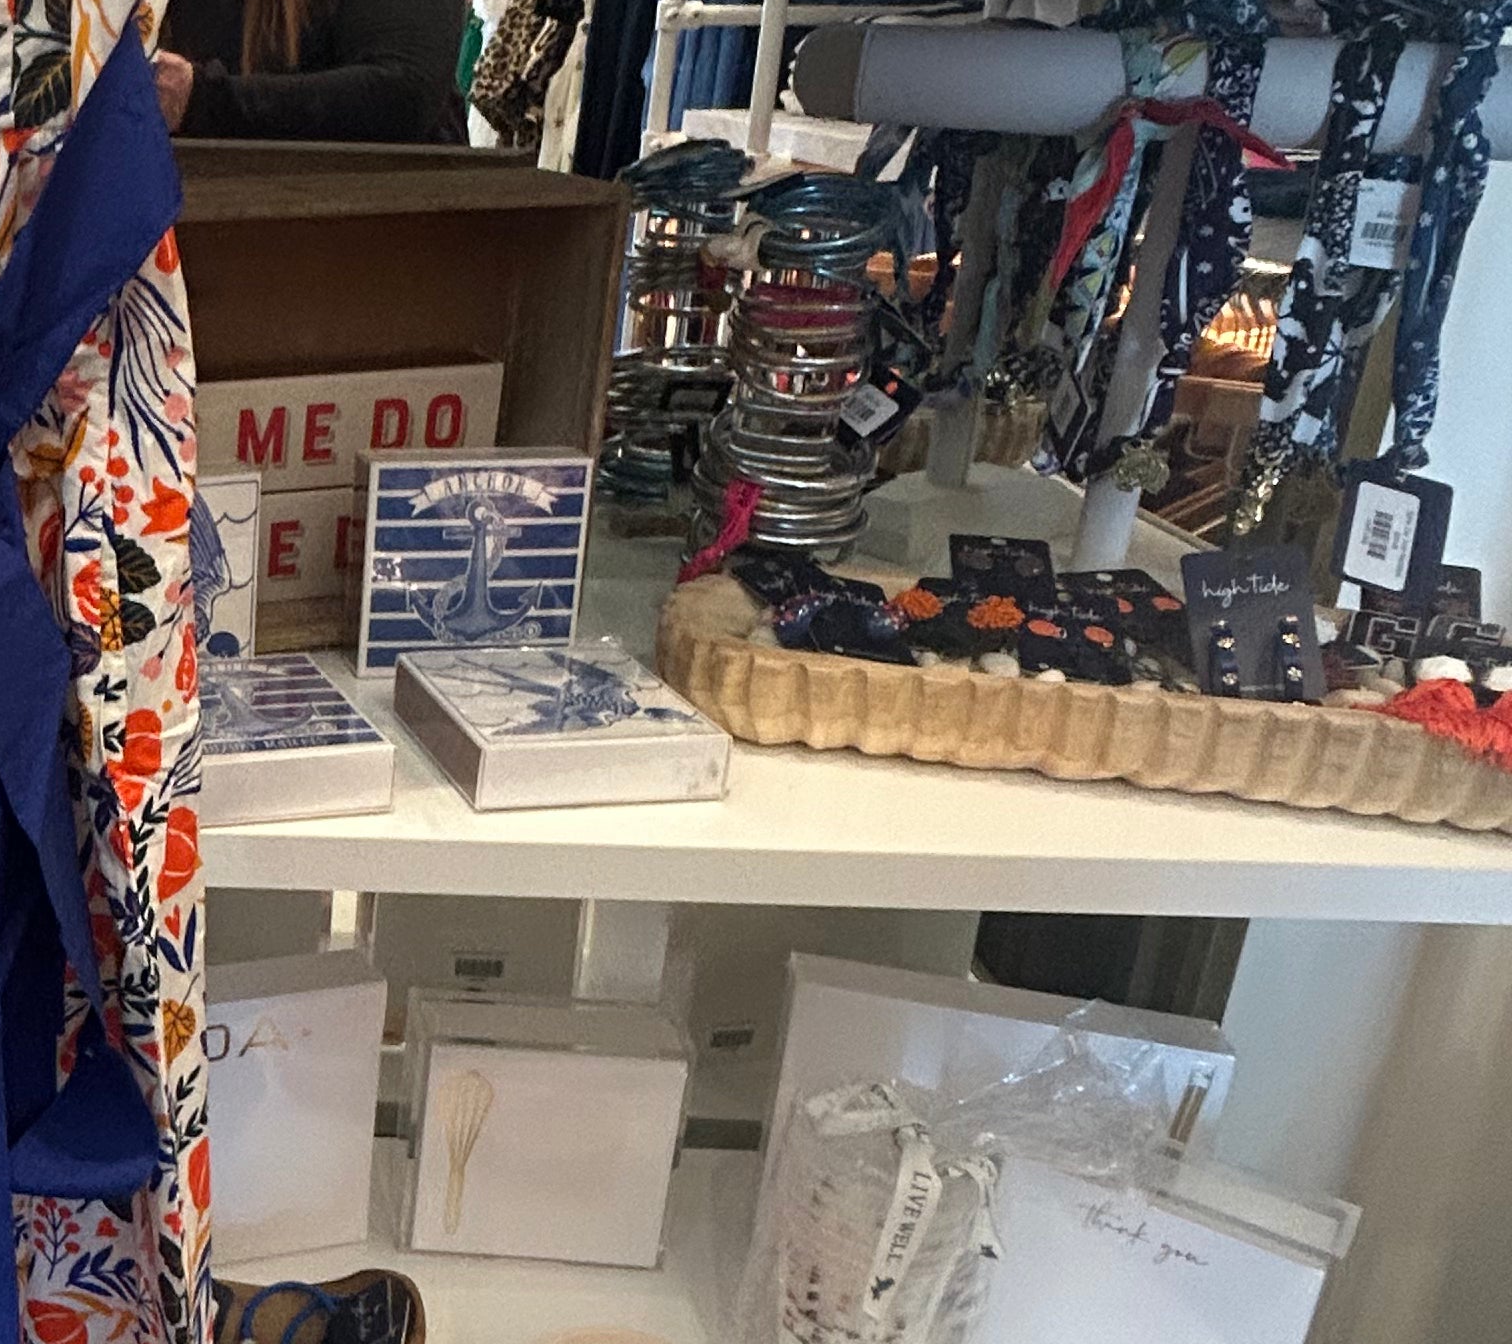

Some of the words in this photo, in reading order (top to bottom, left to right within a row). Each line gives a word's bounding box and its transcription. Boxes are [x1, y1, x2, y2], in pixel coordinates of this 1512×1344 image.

[237, 403, 338, 468] ME
[370, 394, 468, 449] DO
[902, 1169, 933, 1219] LIVE
[886, 1221, 916, 1262] WELL
